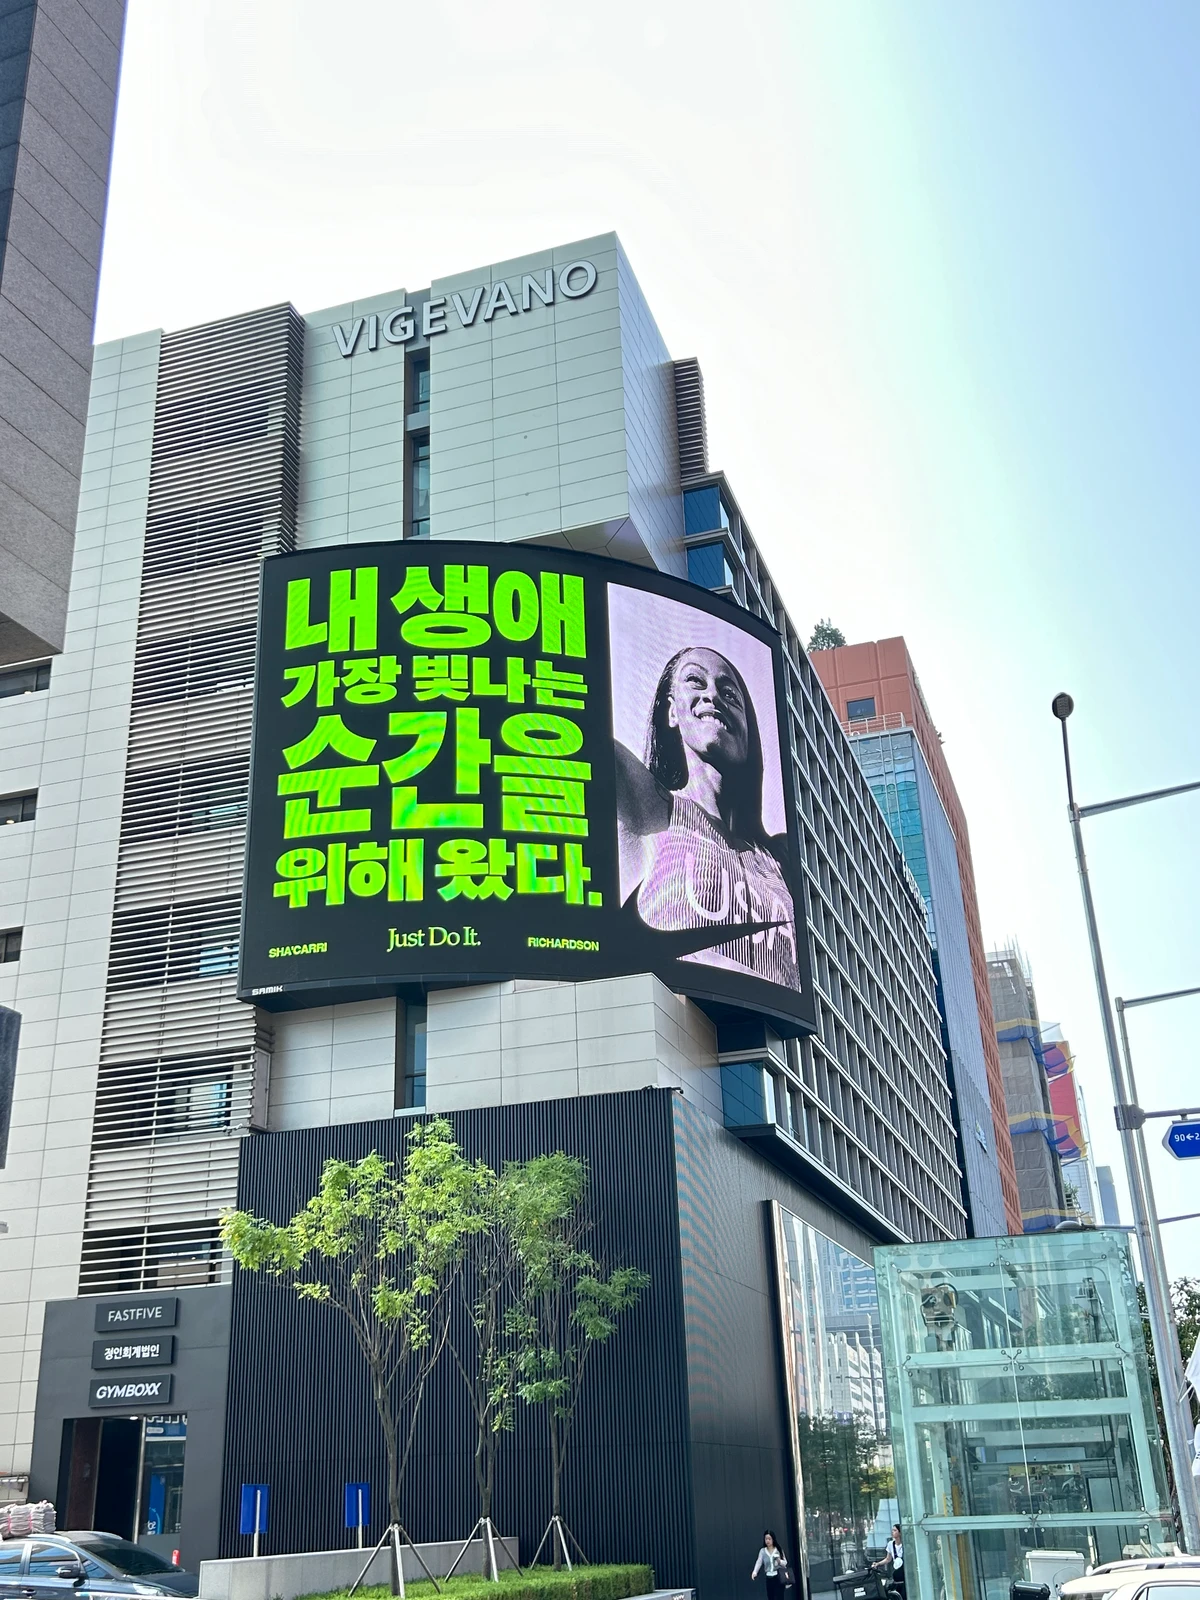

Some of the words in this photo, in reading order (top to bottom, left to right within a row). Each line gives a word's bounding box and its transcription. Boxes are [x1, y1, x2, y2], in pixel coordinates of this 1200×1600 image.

[332, 260, 597, 358] VIGEVANO
[284, 567, 379, 653] 내
[391, 564, 587, 659] 생애
[281, 655, 402, 708] 가장
[412, 655, 588, 710] 빛나는
[277, 707, 592, 839] 순간을
[273, 839, 424, 908] 위해
[435, 838, 603, 907] 왔다.
[386, 927, 425, 952] Just
[428, 926, 460, 947] Do
[462, 926, 482, 946] It.
[527, 936, 599, 951] RICHARDSON
[268, 942, 328, 958] SHA'CARRI
[251, 985, 284, 996] SAMIK
[1174, 1133, 1186, 1142] 90
[107, 1306, 163, 1322] FASTFIVE
[96, 1382, 162, 1399] GYMBOXX
